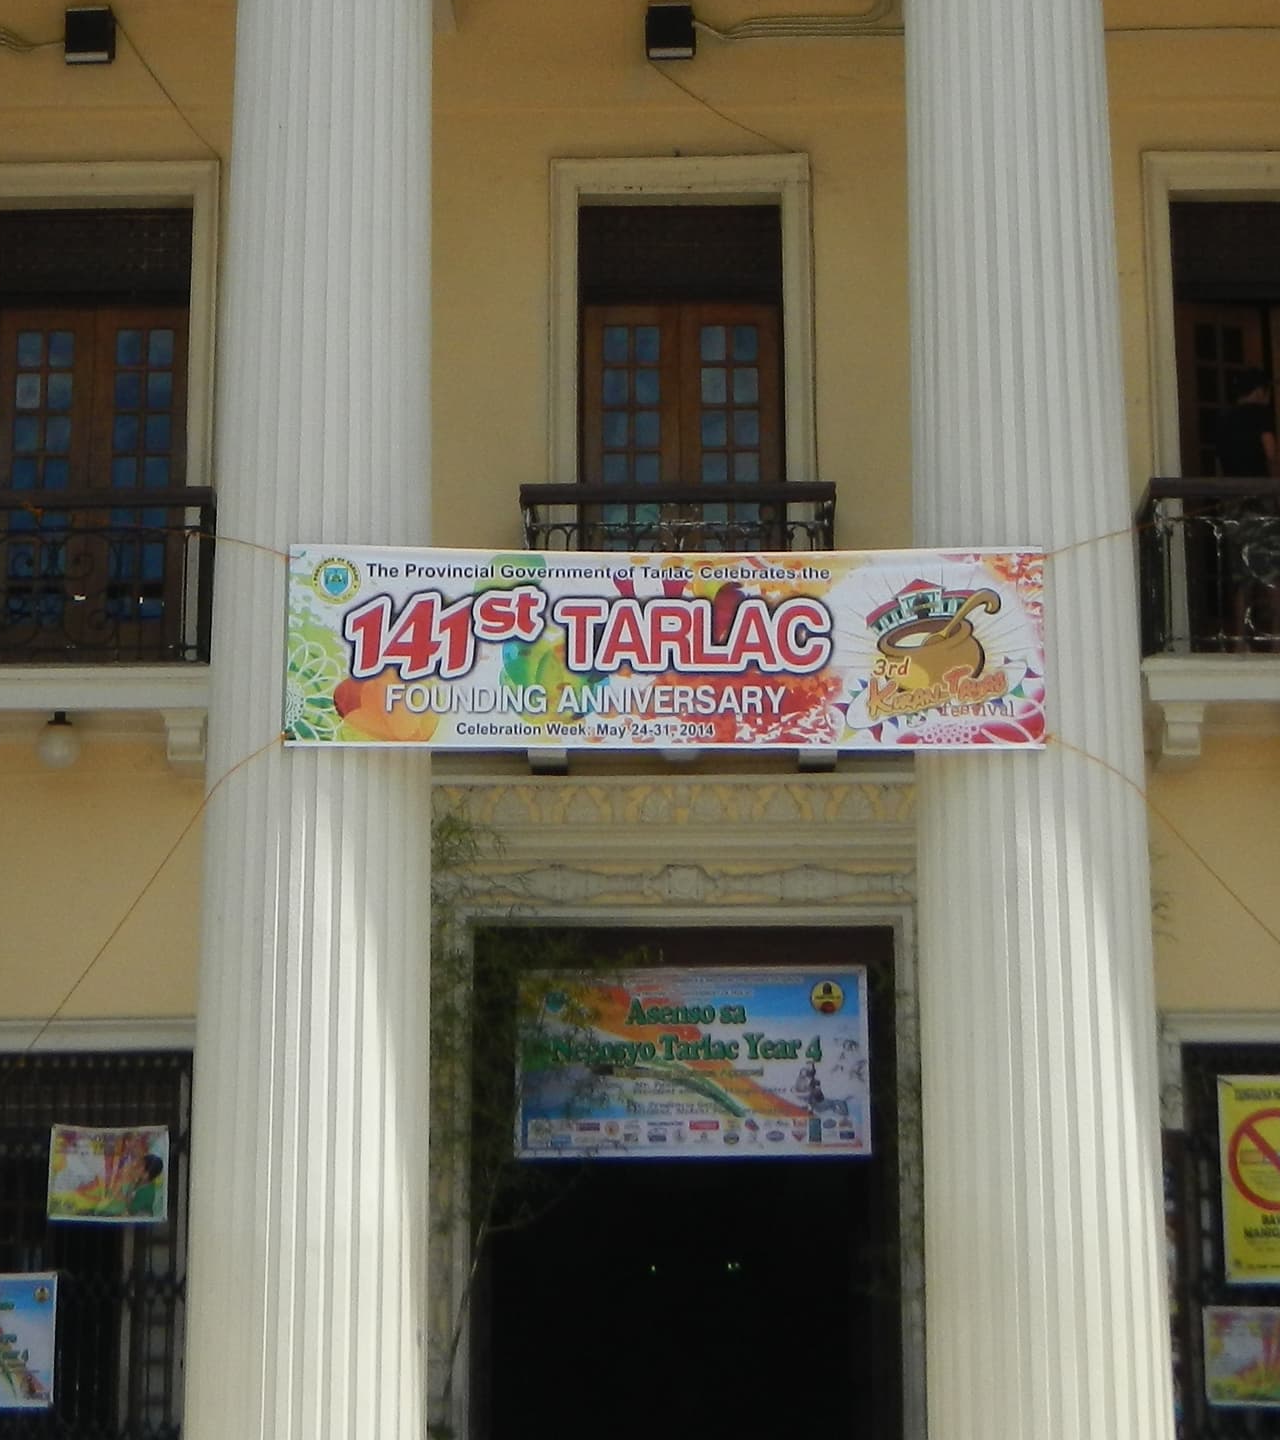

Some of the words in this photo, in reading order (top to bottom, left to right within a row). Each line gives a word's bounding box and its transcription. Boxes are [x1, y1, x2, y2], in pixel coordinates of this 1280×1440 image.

[366, 563, 399, 578] The
[405, 563, 495, 579] Provincial
[500, 564, 611, 580] Government
[617, 566, 634, 580] of
[640, 566, 694, 580] Tarlac
[700, 566, 796, 580] Celebrates
[802, 567, 830, 580] the
[347, 587, 545, 677] 141st
[556, 601, 830, 670] TARLAC
[873, 656, 910, 677] 3rd
[385, 684, 548, 714] FOUNDING
[557, 685, 788, 714] ANNIVERSARY
[456, 722, 542, 736] Celebration
[546, 723, 591, 736] Week:
[595, 723, 626, 739] May
[631, 723, 675, 738] 24-31,
[679, 723, 714, 737] 2014
[627, 998, 715, 1025] Asenso
[719, 1004, 747, 1025] sa
[658, 1032, 740, 1060] Tarlac
[742, 1031, 803, 1060] Year
[805, 1033, 823, 1061] 4
